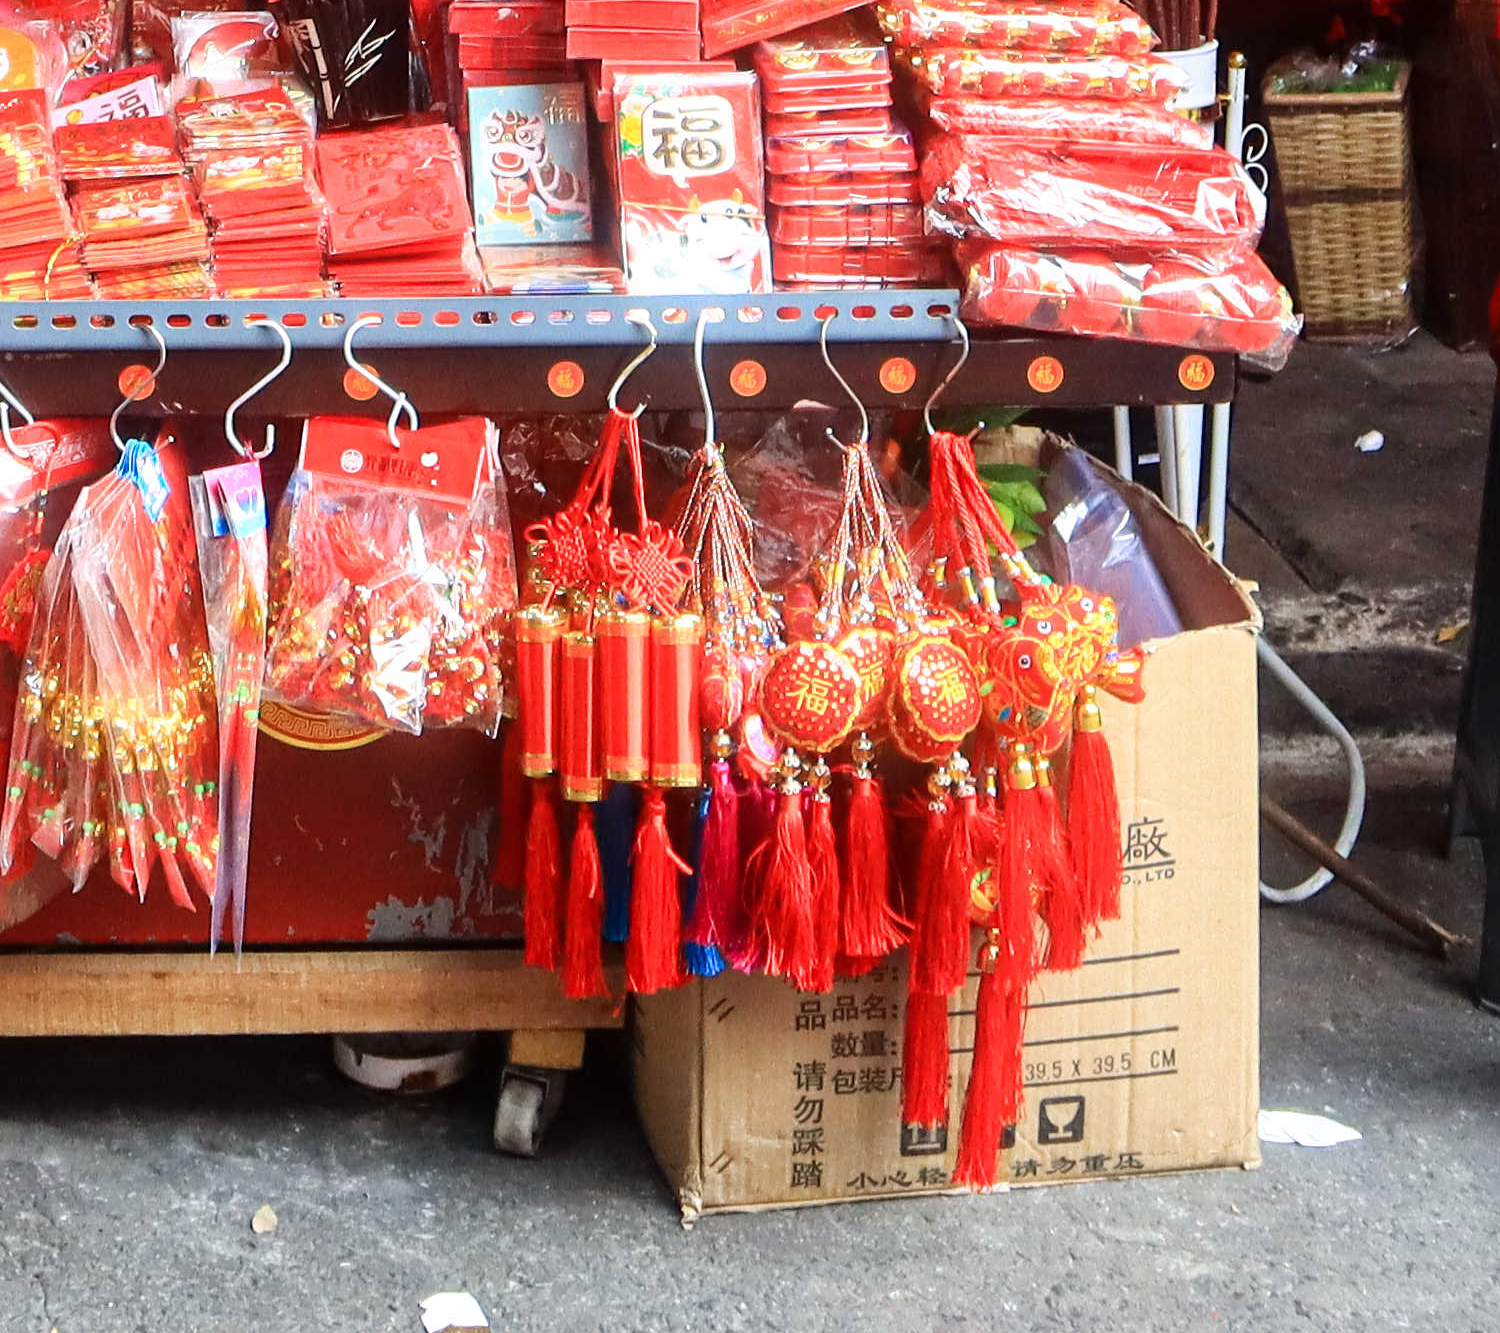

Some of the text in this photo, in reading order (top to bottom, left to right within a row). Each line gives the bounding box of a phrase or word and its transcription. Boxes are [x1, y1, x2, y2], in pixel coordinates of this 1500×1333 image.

[652, 106, 723, 169] 福
[795, 675, 829, 714] 福
[940, 673, 966, 713] 福
[1120, 868, 1175, 885] O.,LTD
[832, 993, 899, 1021] 品名:
[831, 1031, 899, 1058] 数量:
[1025, 1047, 1175, 1081] 39.5 X 39.5 CM
[791, 1062, 827, 1189] 请勿踩踏
